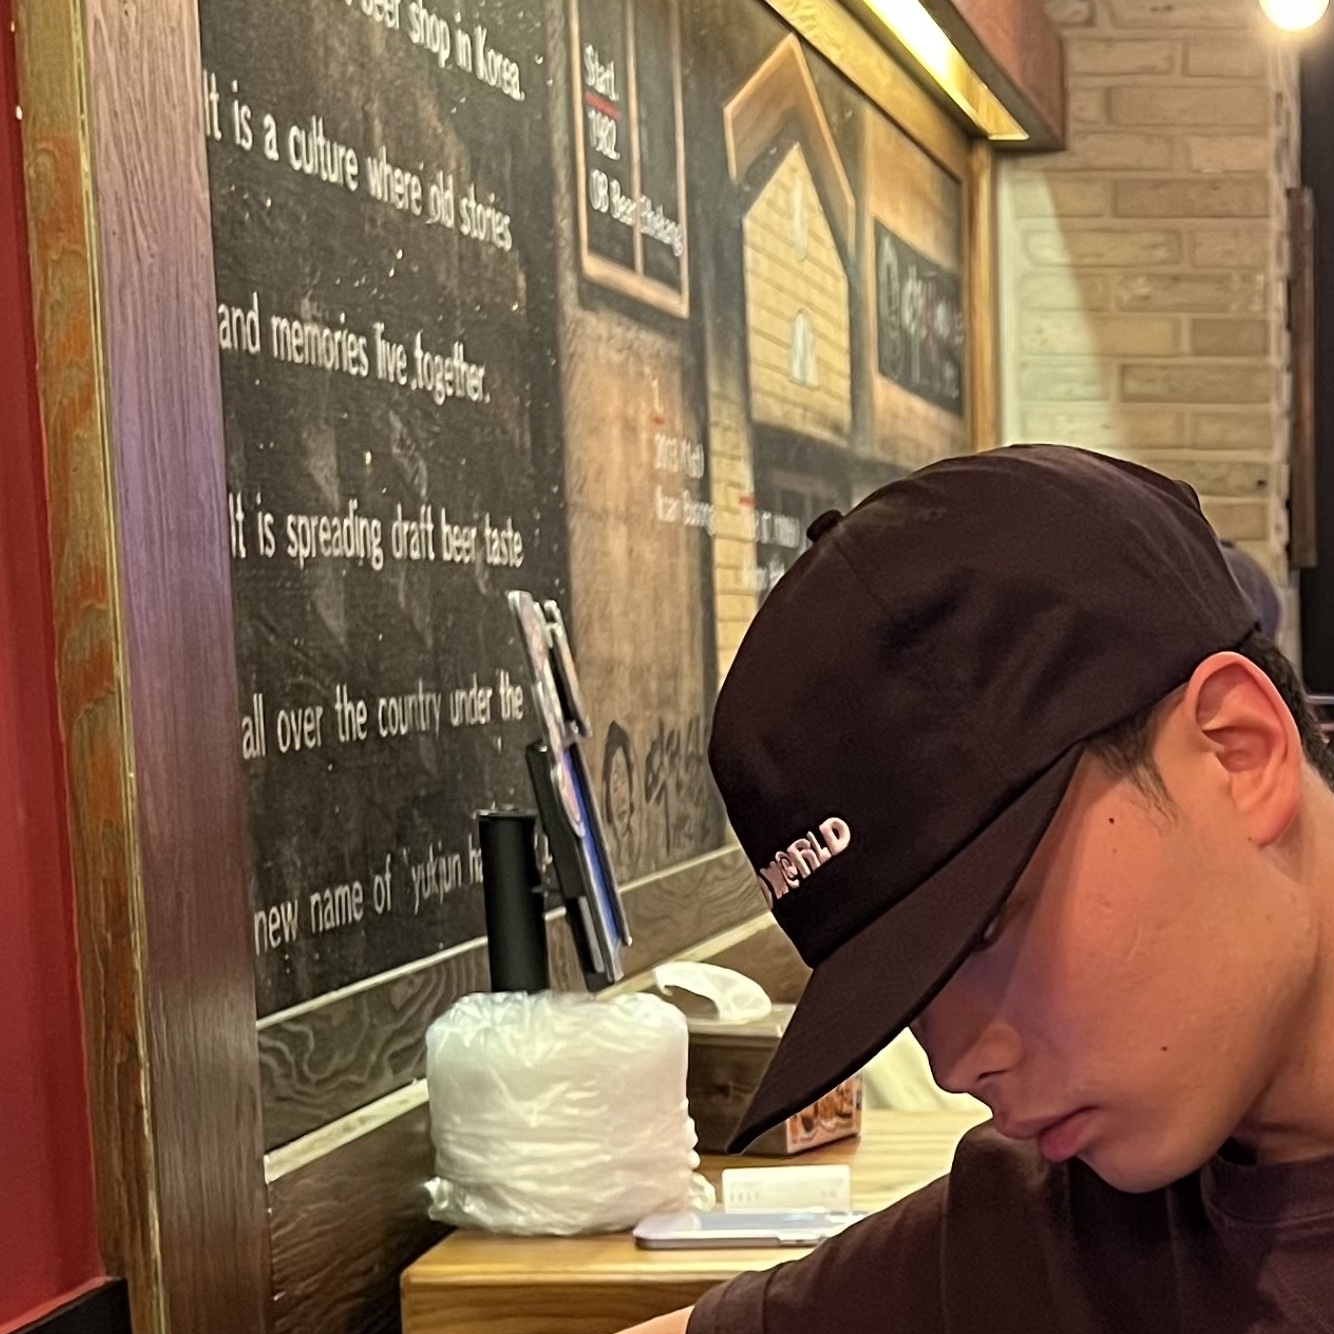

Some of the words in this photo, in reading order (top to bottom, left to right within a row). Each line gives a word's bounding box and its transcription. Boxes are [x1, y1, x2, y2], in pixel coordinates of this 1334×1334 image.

[408, 0, 450, 68] shop
[454, 12, 473, 73] in
[202, 68, 222, 141] It
[231, 79, 253, 151] is
[263, 112, 281, 161] a
[287, 115, 359, 192] culture
[366, 145, 423, 216] where
[429, 170, 455, 229] old
[459, 183, 512, 251] stories
[217, 291, 261, 355] and
[270, 312, 369, 377] memories
[373, 322, 408, 385] live
[228, 492, 247, 558] It
[256, 492, 275, 558] is
[287, 499, 384, 571] spreading
[391, 503, 436, 561] draft
[440, 507, 477, 564] beer
[484, 516, 525, 568] taste
[241, 693, 266, 760] all
[276, 705, 324, 753] over
[335, 683, 368, 743] the
[377, 677, 441, 737] country
[449, 672, 493, 727] under
[498, 669, 524, 721] the
[253, 900, 299, 955] new
[310, 880, 364, 934] name
[373, 853, 392, 914] of
